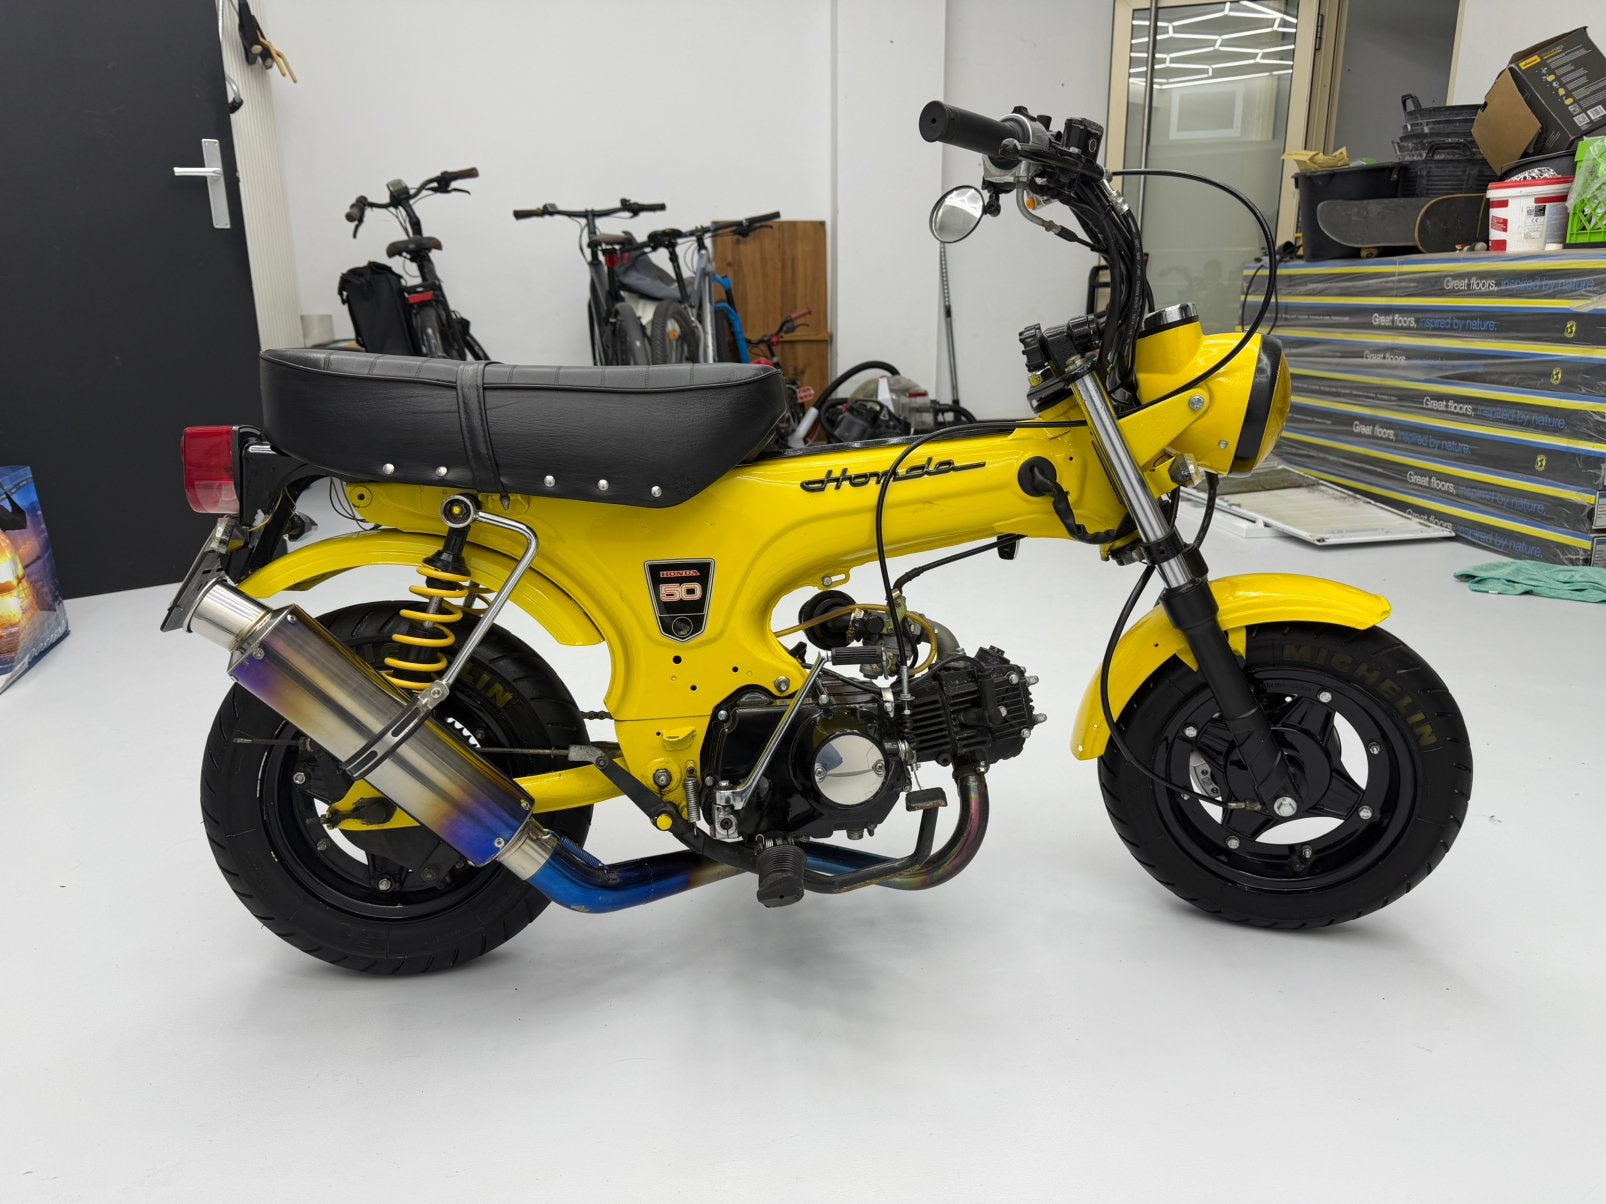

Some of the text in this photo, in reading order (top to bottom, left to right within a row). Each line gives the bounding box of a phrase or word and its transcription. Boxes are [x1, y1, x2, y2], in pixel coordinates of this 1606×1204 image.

[1443, 276, 1468, 290] Great
[1470, 277, 1498, 291] floors,
[1501, 277, 1540, 292] inspired
[1542, 277, 1555, 291] by
[1371, 313, 1392, 326] Great
[1394, 314, 1417, 329] floors,
[1452, 317, 1463, 331] by
[1465, 318, 1497, 331] nature.
[1363, 350, 1406, 362] Great floors
[1423, 396, 1446, 411] Great
[1448, 400, 1474, 417] floors,
[1516, 409, 1529, 425] by
[1531, 413, 1567, 429] nature.
[1353, 420, 1372, 436] Great
[1374, 424, 1396, 441] floors,
[1429, 434, 1440, 450] by
[1441, 439, 1471, 455] nature.
[800, 456, 986, 493] Honda
[1407, 471, 1429, 487] Great
[1431, 475, 1456, 495] floors,
[1496, 490, 1509, 507] by
[1495, 532, 1507, 549] by
[1509, 540, 1543, 558] nature.
[660, 569, 700, 578] HONDA
[659, 582, 703, 602] 50
[1282, 643, 1438, 747] MICHELIN
